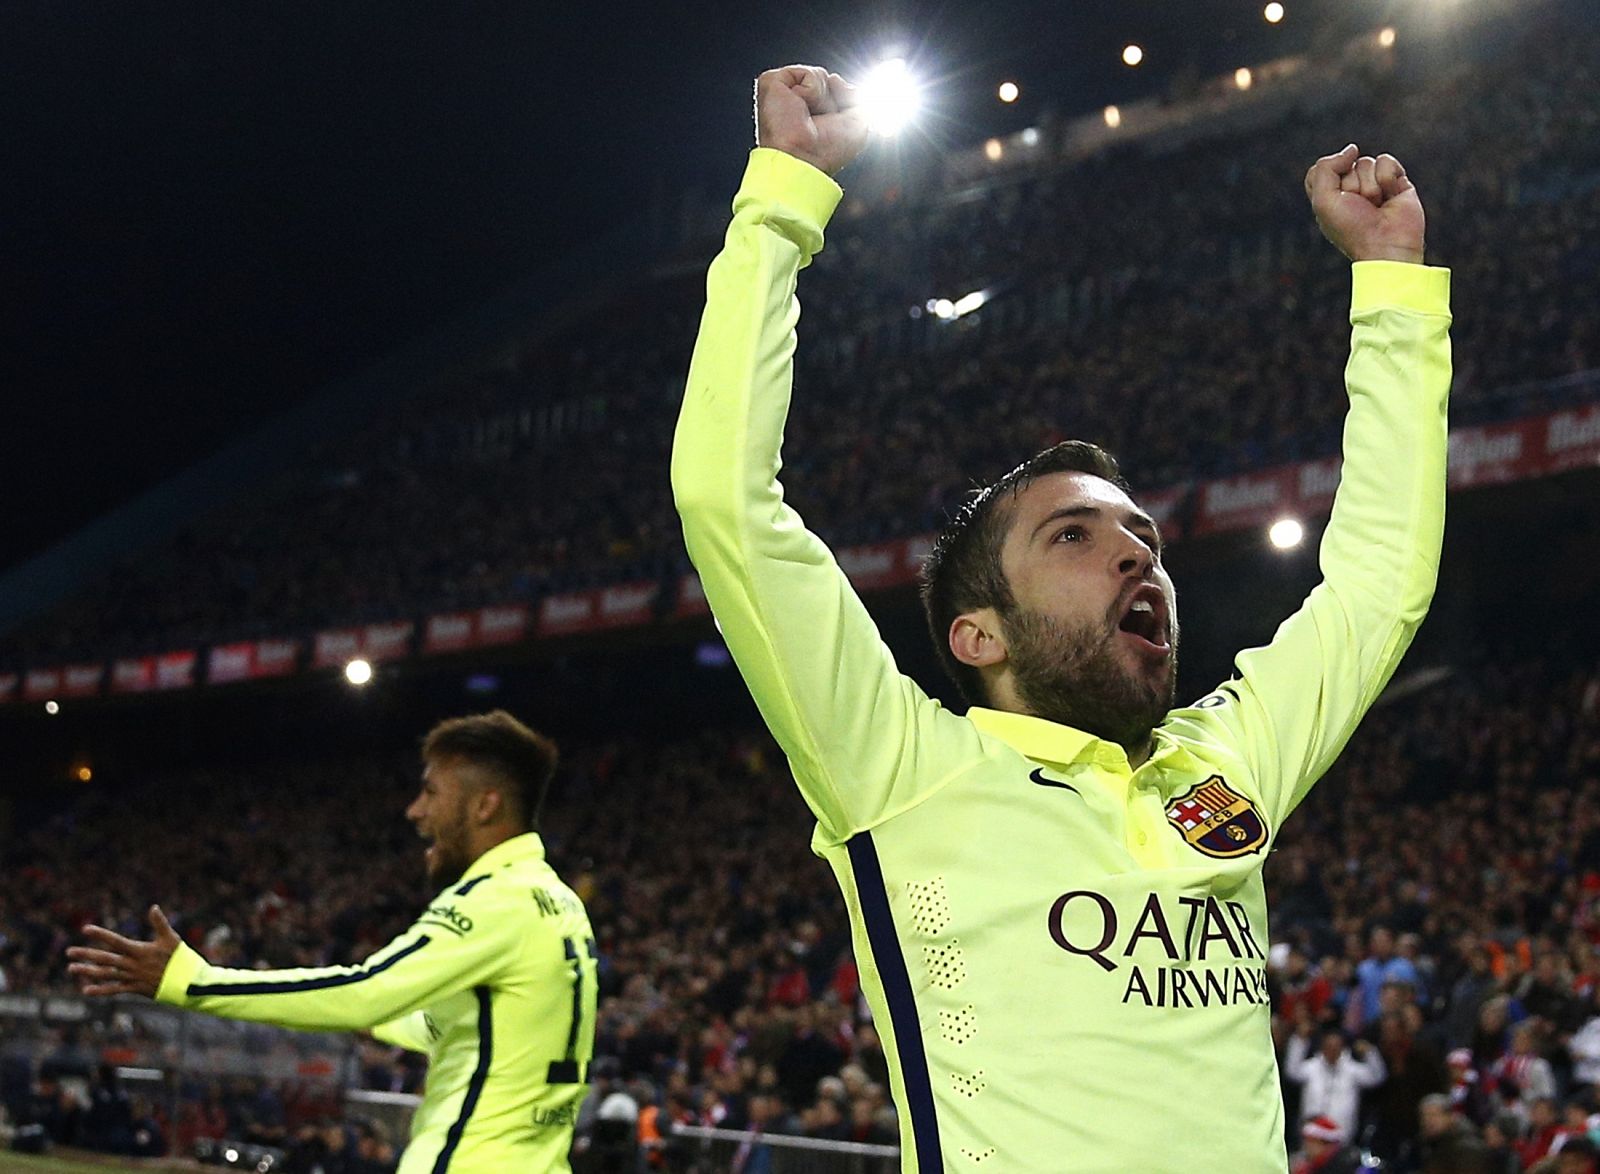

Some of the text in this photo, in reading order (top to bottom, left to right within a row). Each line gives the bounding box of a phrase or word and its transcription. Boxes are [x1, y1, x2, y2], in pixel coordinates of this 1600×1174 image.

[1204, 809, 1233, 829] FCB
[428, 904, 473, 932] eko
[1048, 890, 1265, 972] QATAR
